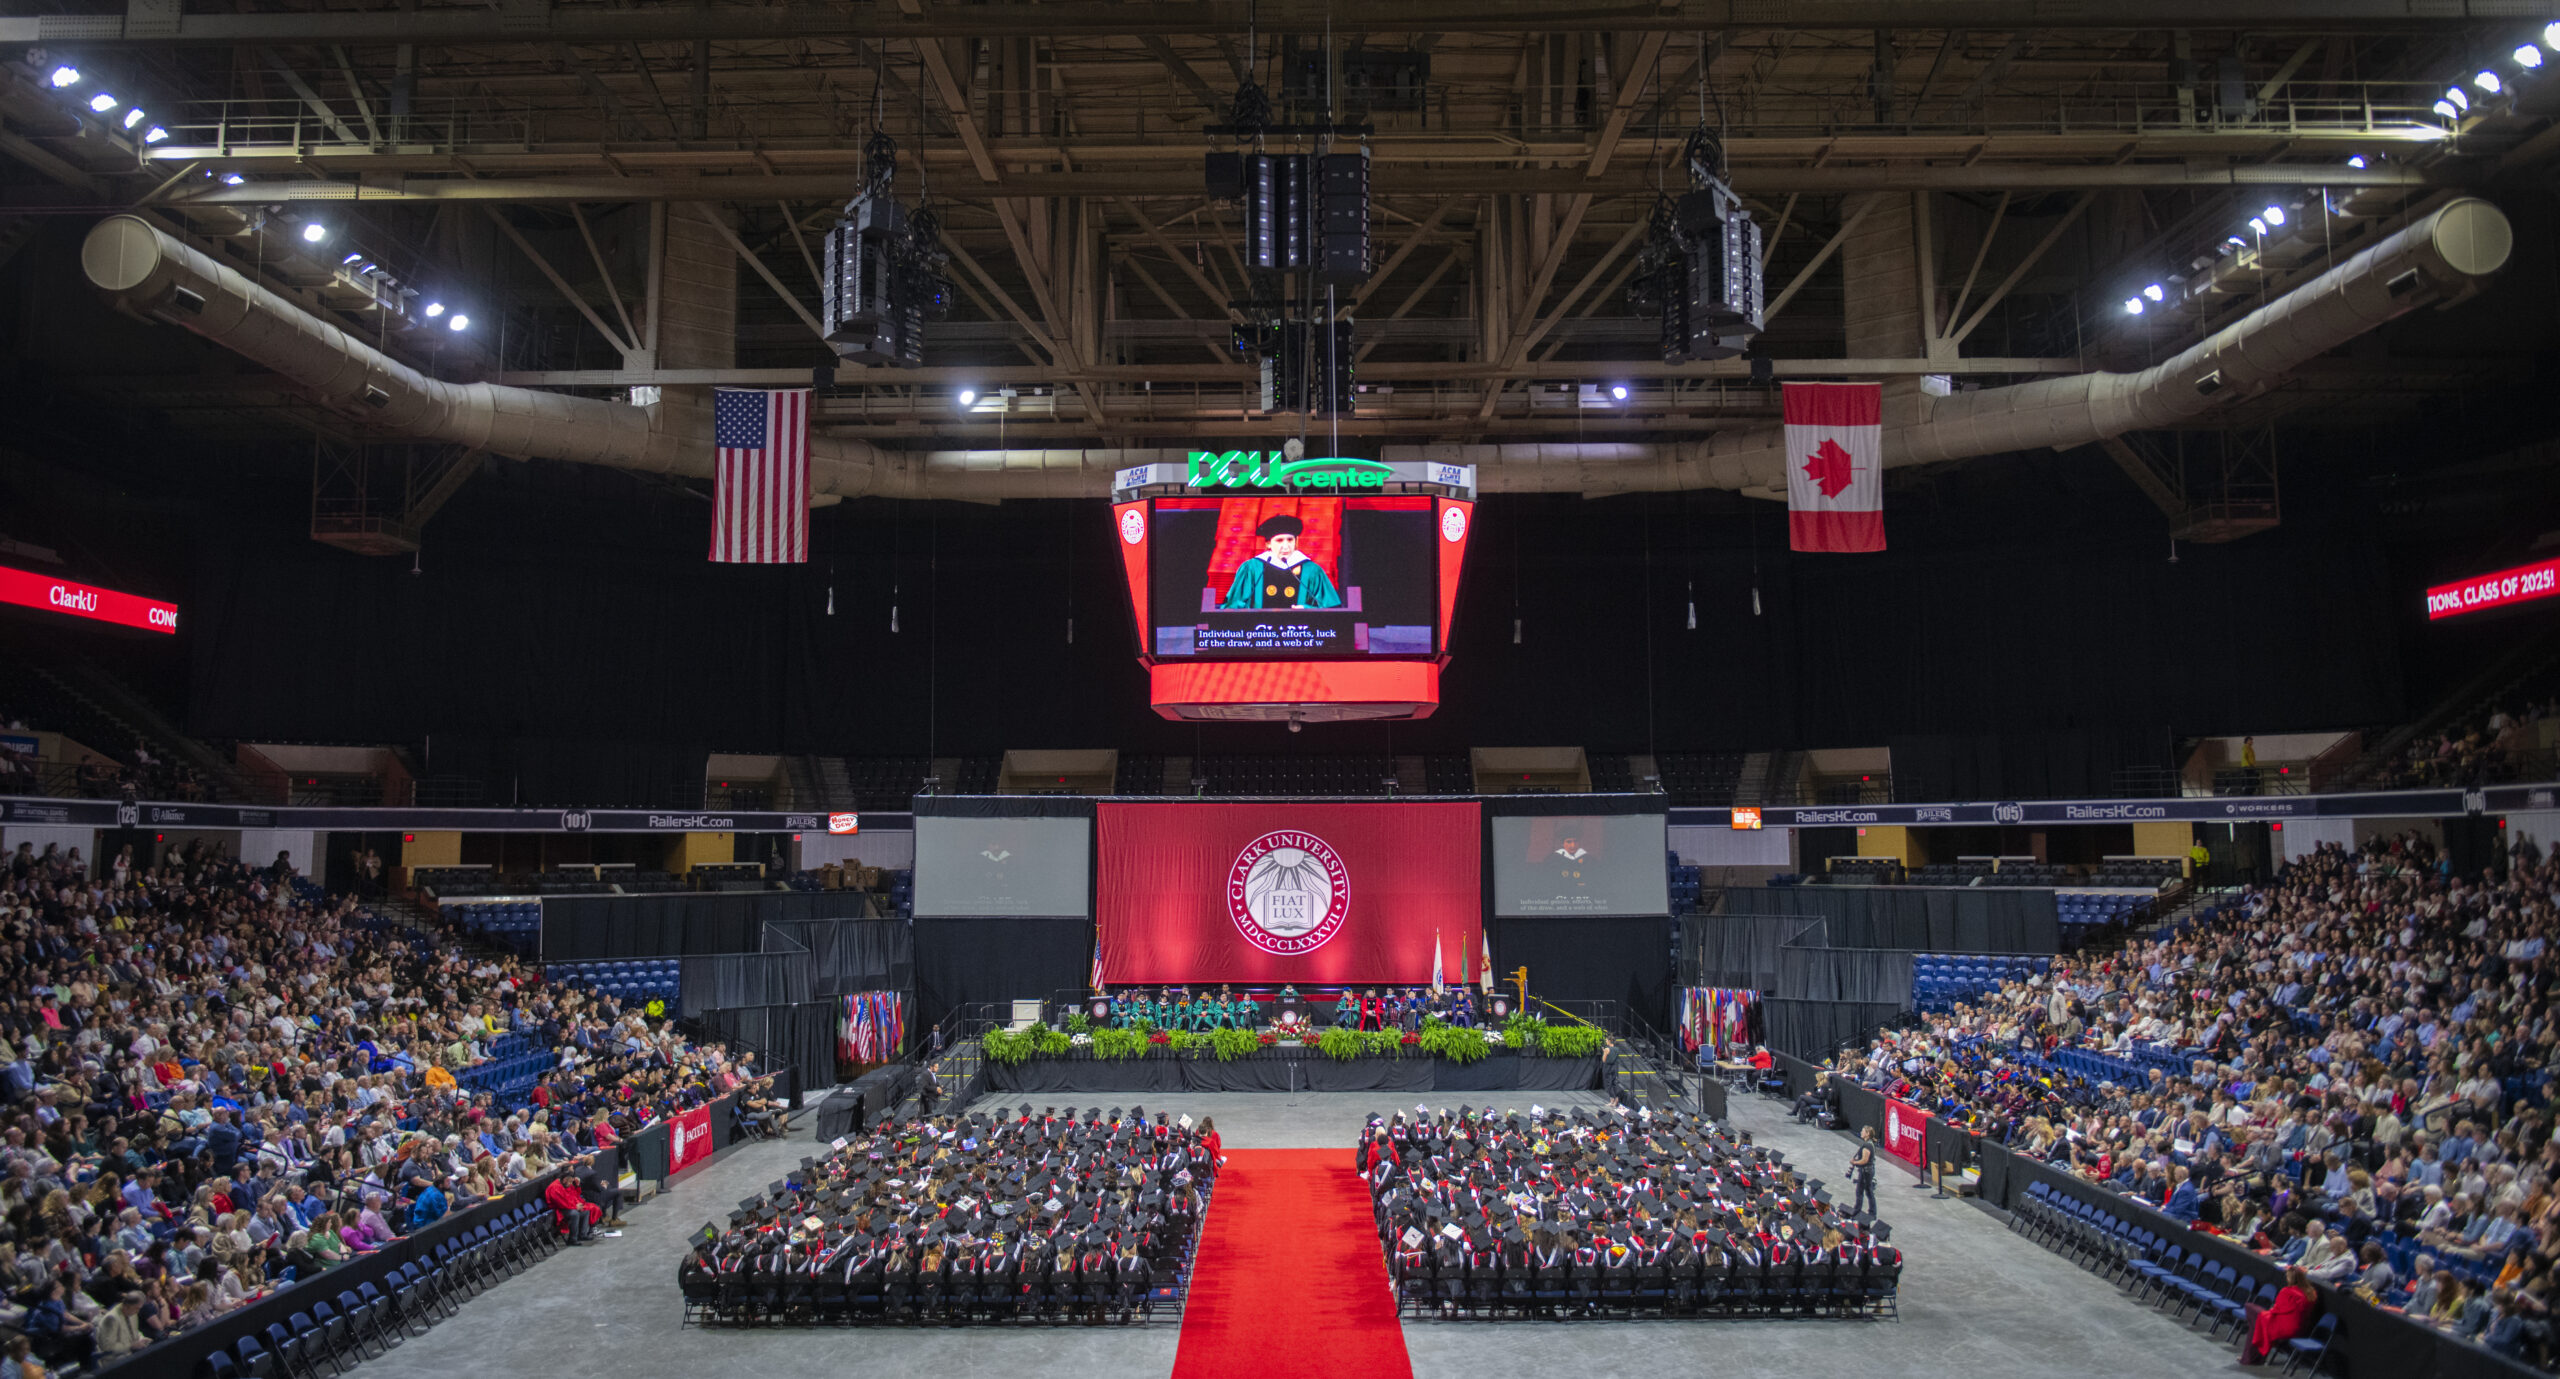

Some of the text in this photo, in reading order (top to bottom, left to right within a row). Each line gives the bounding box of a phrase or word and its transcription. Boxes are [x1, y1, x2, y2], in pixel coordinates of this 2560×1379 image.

[1188, 451, 1389, 488] DCU center
[2464, 581, 2500, 604] CLASS
[2501, 577, 2518, 597] OF
[2521, 569, 2554, 593] 2025!
[50, 585, 98, 611] ClarkU
[1199, 629, 1337, 640] Individual genius, efforts, luck
[1198, 639, 1209, 647] of
[1210, 639, 1226, 647] the
[1227, 639, 1254, 648] draw,
[1255, 639, 1273, 647] and
[1282, 639, 1302, 647] web
[1303, 639, 1314, 647] of
[1996, 806, 2019, 820] 105
[2066, 805, 2165, 818] RailersHC.com
[2239, 804, 2293, 812] WORKERS
[120, 806, 137, 824] 125
[566, 813, 587, 828] 101
[650, 815, 733, 828] RailersHC.com
[1796, 810, 1877, 822] RailersHC.com
[1916, 809, 1951, 821] RAILERS
[786, 816, 817, 828] RAILERS
[1232, 834, 1346, 900] CLARK UNIVERSITY
[1272, 895, 1306, 906] FIAT
[1273, 908, 1304, 918] LUX
[1238, 912, 1340, 950] MDCCCLXXXVII
[686, 1122, 708, 1143] FACULTY
